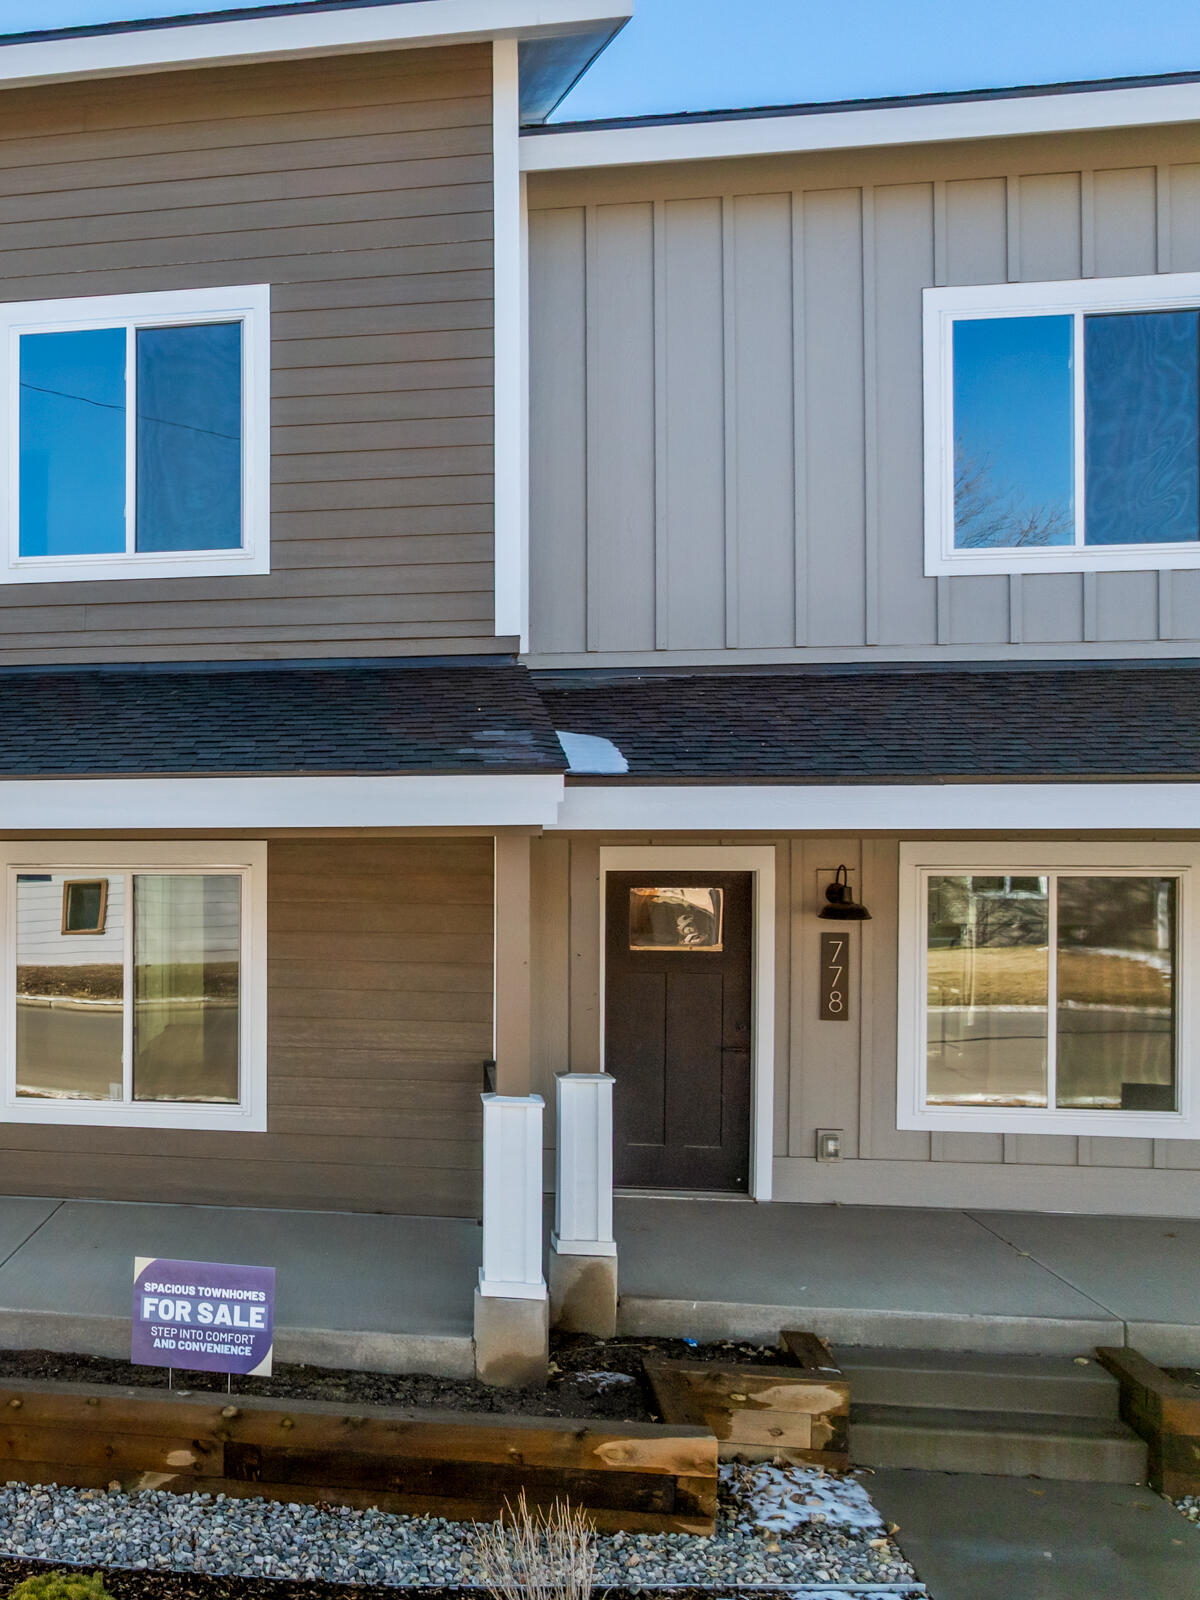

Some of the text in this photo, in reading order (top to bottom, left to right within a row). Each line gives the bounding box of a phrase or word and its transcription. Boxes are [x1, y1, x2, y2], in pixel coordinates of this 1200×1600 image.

[828, 941, 843, 1013] 778
[144, 1282, 266, 1301] SPACIOUS TOWNHOMES
[143, 1297, 266, 1329] FOR SALE
[150, 1326, 255, 1344] STEP INTO COMFORT
[153, 1338, 252, 1356] AND CONVENIENCE
